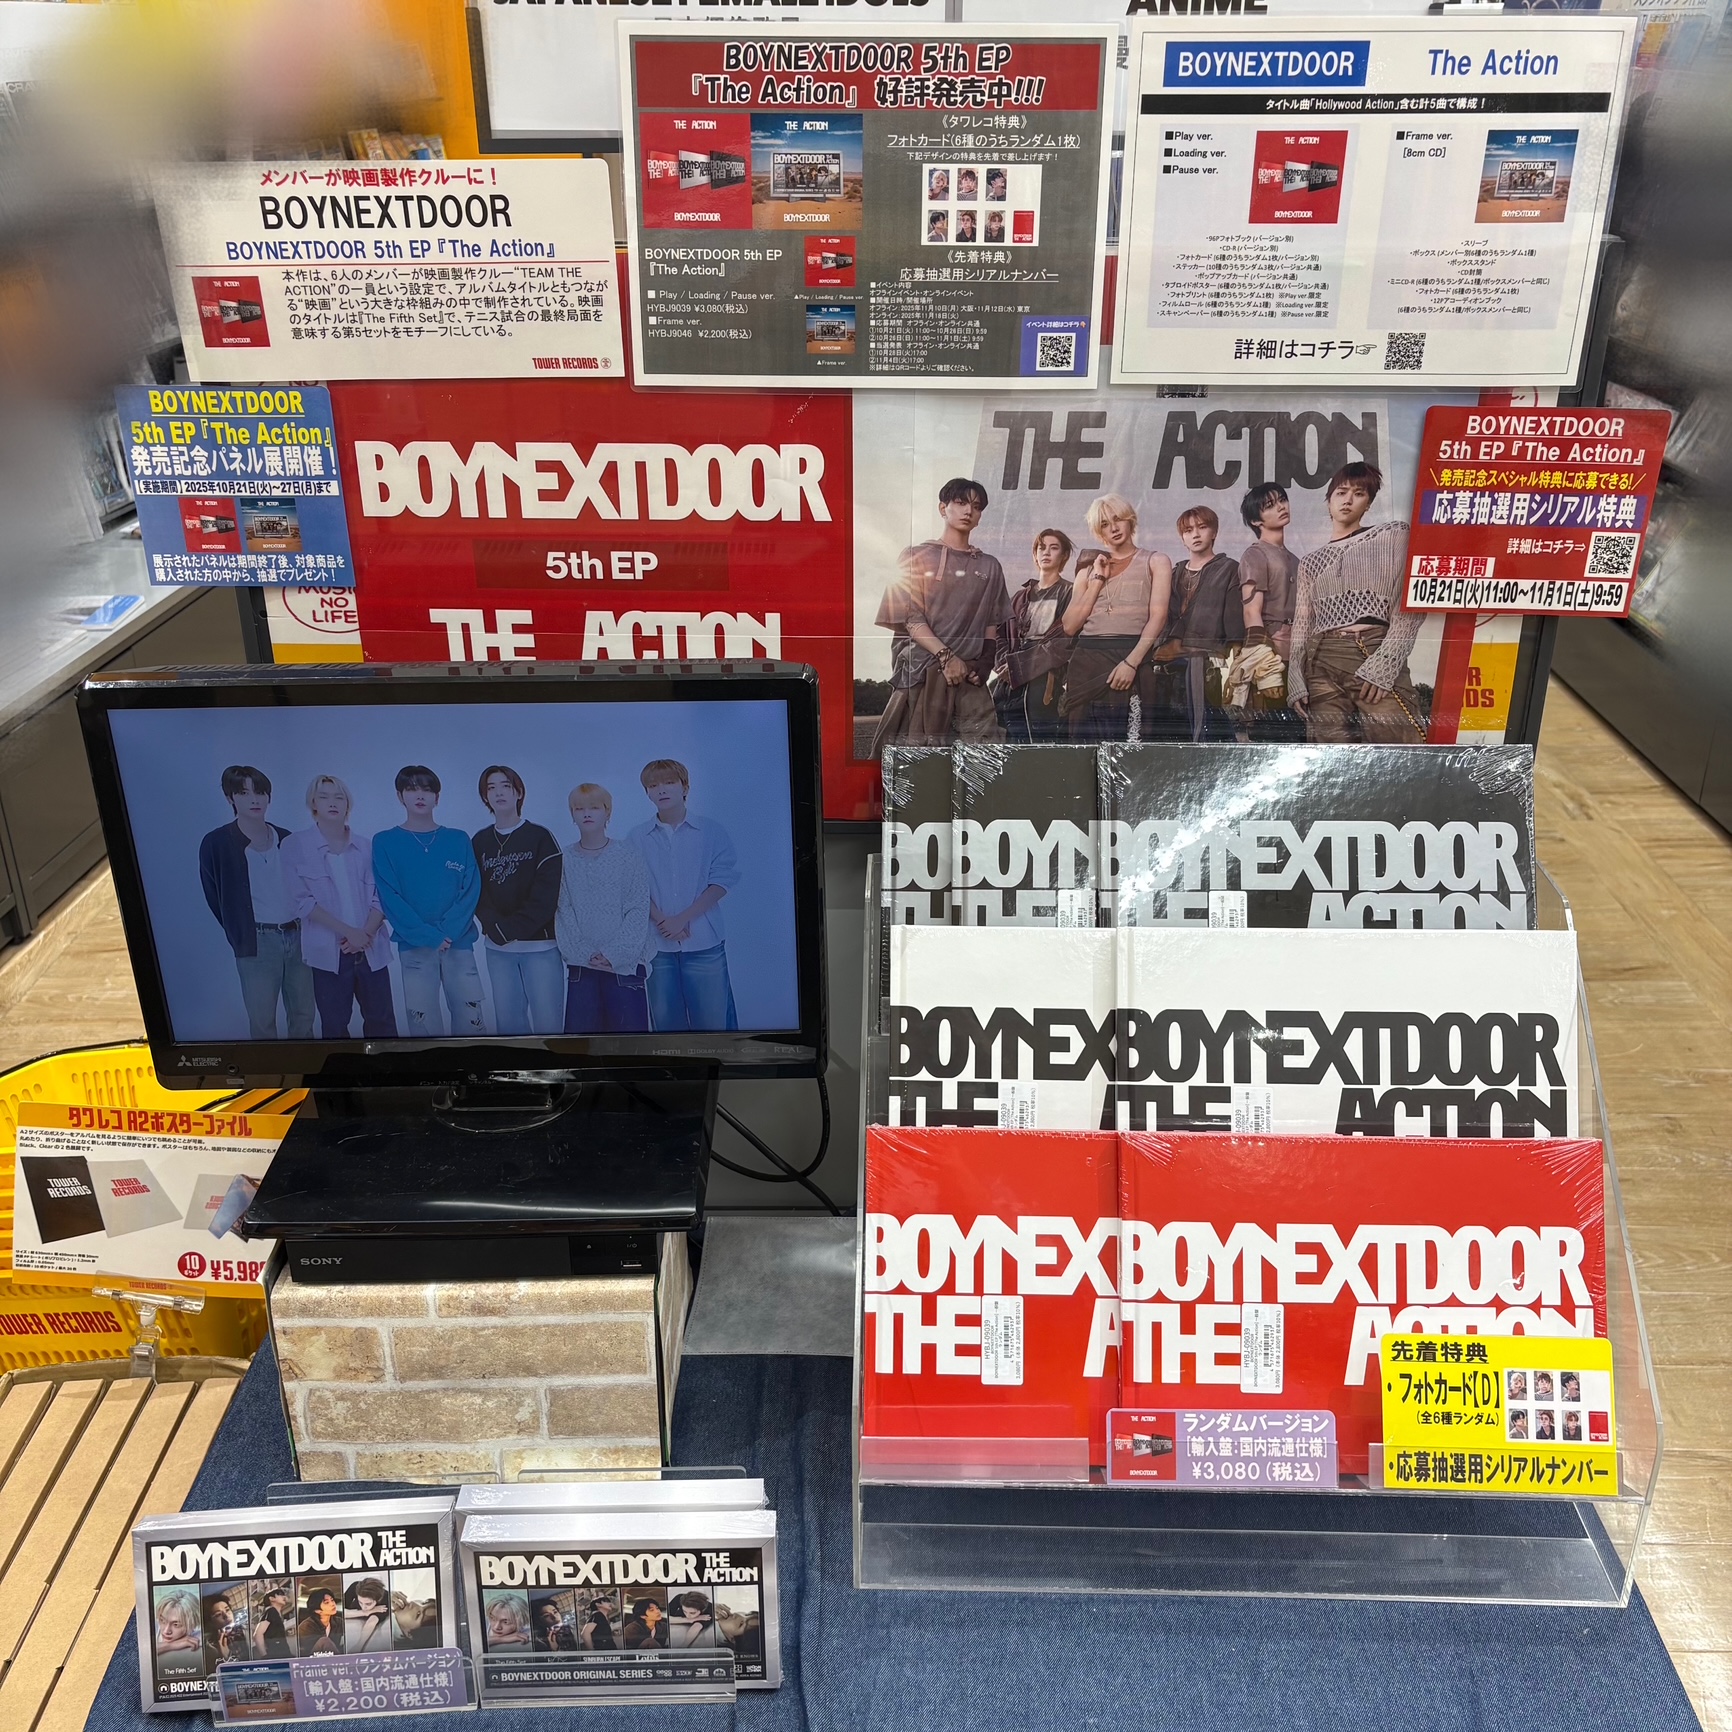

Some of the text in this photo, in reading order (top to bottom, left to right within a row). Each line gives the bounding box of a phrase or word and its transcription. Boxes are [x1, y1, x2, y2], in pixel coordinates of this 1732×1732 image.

[722, 43, 1012, 73] BOYNEXTDOOR 5th EP
[1177, 51, 1356, 78] BOYNEXTDOOR
[1427, 49, 1560, 77] The Action
[690, 75, 751, 103] 『The
[758, 76, 860, 108] Action』
[674, 120, 717, 130] THE ACTION
[785, 121, 829, 131] THE ACTION
[940, 113, 1029, 131] 《タワレコ特典》
[887, 132, 1081, 150] フォトカード(6種のうちランダム1枚)
[1174, 131, 1214, 144] Play ver.
[1405, 131, 1454, 142] Frame ver.
[1173, 148, 1228, 161] Loading ver.
[1425, 147, 1447, 160] CD]
[1171, 165, 1219, 175] Pause ver.
[259, 195, 513, 230] BOYNEXTDOOR
[674, 212, 721, 223] BOYNEXTDOOR
[783, 213, 831, 223] BOYNEXTDOOR
[226, 238, 556, 261] BOYNEXTDOOR 5th EP 『The Action』
[645, 248, 783, 261] BOYNEXTDOOR 5th EP
[947, 250, 1013, 264] 《先着特典》
[558, 267, 582, 278] THE
[900, 267, 1059, 281] 応募抽選用シリアルナンバー
[659, 290, 776, 301] Play Loading Pause ver.
[389, 312, 415, 323] Fifth
[646, 303, 749, 314] HYBJ9039 ¥3,080(税込)
[657, 316, 702, 326] Frame ver.
[648, 329, 753, 340] HYBJ9046 ¥2,200(税込)
[1234, 338, 1355, 360] 詳細はコチラ
[532, 357, 599, 370] TOWER RECORDS
[148, 390, 304, 414] BOYNEXTDOOR
[131, 421, 166, 444] 5th
[169, 421, 196, 444] EP
[1466, 415, 1625, 437] BOYNEXTDOOR
[992, 411, 1380, 490] THE ACTION
[1438, 440, 1472, 460] 5th
[1478, 441, 1505, 461] EP
[354, 440, 833, 522] BOYNEXTDOOR
[1432, 490, 1638, 528] 応募抽選用シリアル特典
[153, 554, 346, 568] 展示されたパネルは期間終了後、対象商品を
[545, 551, 659, 581] 5th EP
[1417, 555, 1488, 577] 応募期間
[320, 597, 349, 608] NO
[312, 610, 358, 623] LIFE
[430, 608, 782, 662] THE ACTION
[1099, 820, 1528, 893] BOYNEXTDOOR
[1110, 1008, 1568, 1086] BOYNEXTDOOR
[1335, 1087, 1568, 1138] ACTION
[47, 1177, 81, 1187] TOWER
[110, 1177, 141, 1186] TOWER
[111, 1184, 151, 1197] RECORDS
[47, 1185, 92, 1199] RECORDS
[184, 1255, 199, 1270] 10
[300, 1256, 343, 1267] SONY
[1121, 1219, 1592, 1306] BOYNEXTDOOR
[210, 1260, 266, 1282] ¥5,98
[0, 1310, 123, 1335] OWER RECORDS
[865, 1294, 982, 1376] THE
[1121, 1302, 1242, 1384] THE
[1390, 1341, 1490, 1363] 先着特典
[1183, 1413, 1330, 1433] ランダムバージョン
[151, 1530, 407, 1583] BOYNEXTDOOR THE
[378, 1545, 435, 1567] ACTION
[478, 1552, 731, 1587] BOYNEXTDOOR THE
[702, 1566, 759, 1583] ACTION
[501, 1670, 572, 1682] BOYNEXTDOOR
[573, 1669, 618, 1681] ORIGINAL
[619, 1668, 653, 1680] SERIES
